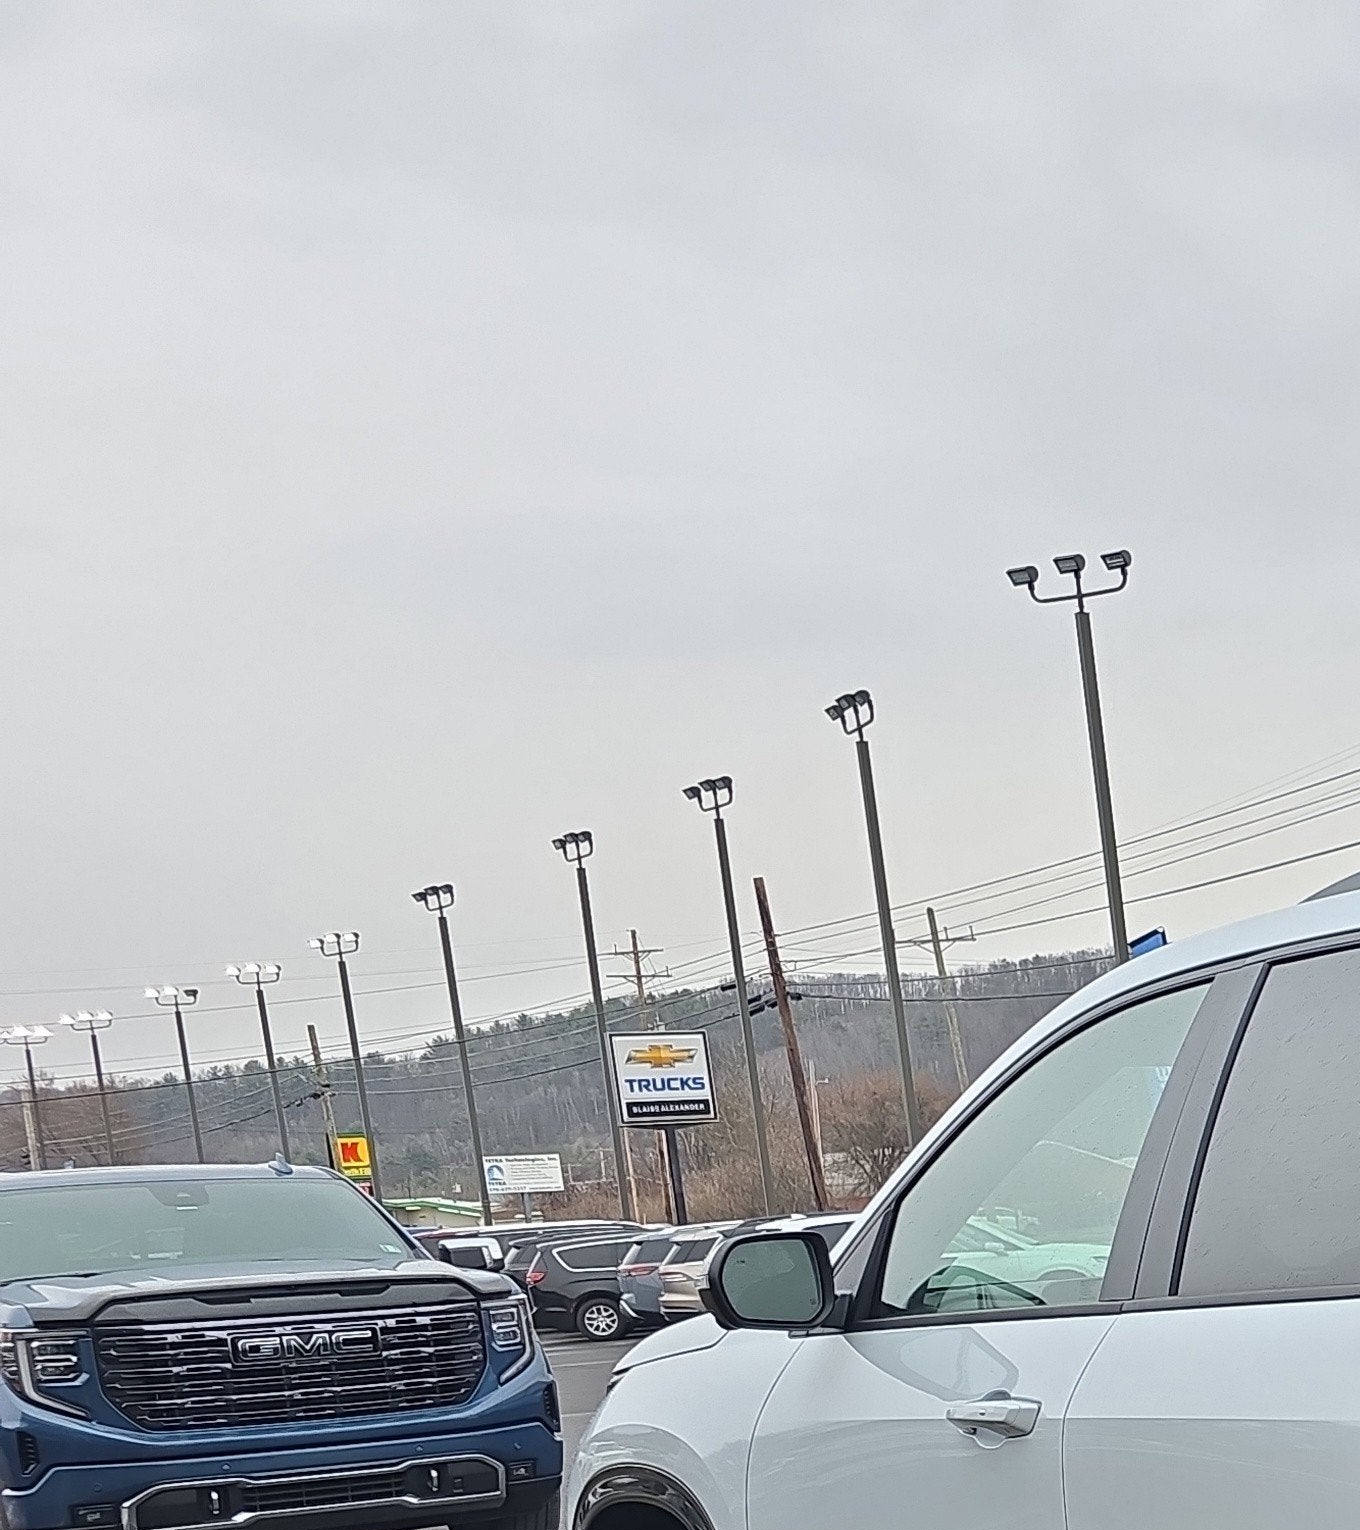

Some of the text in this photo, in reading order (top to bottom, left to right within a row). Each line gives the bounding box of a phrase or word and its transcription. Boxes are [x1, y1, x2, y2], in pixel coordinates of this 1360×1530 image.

[624, 1077, 706, 1093] TRUCKS
[660, 1103, 705, 1112] ALEXANDER
[238, 1330, 374, 1361] GMC
